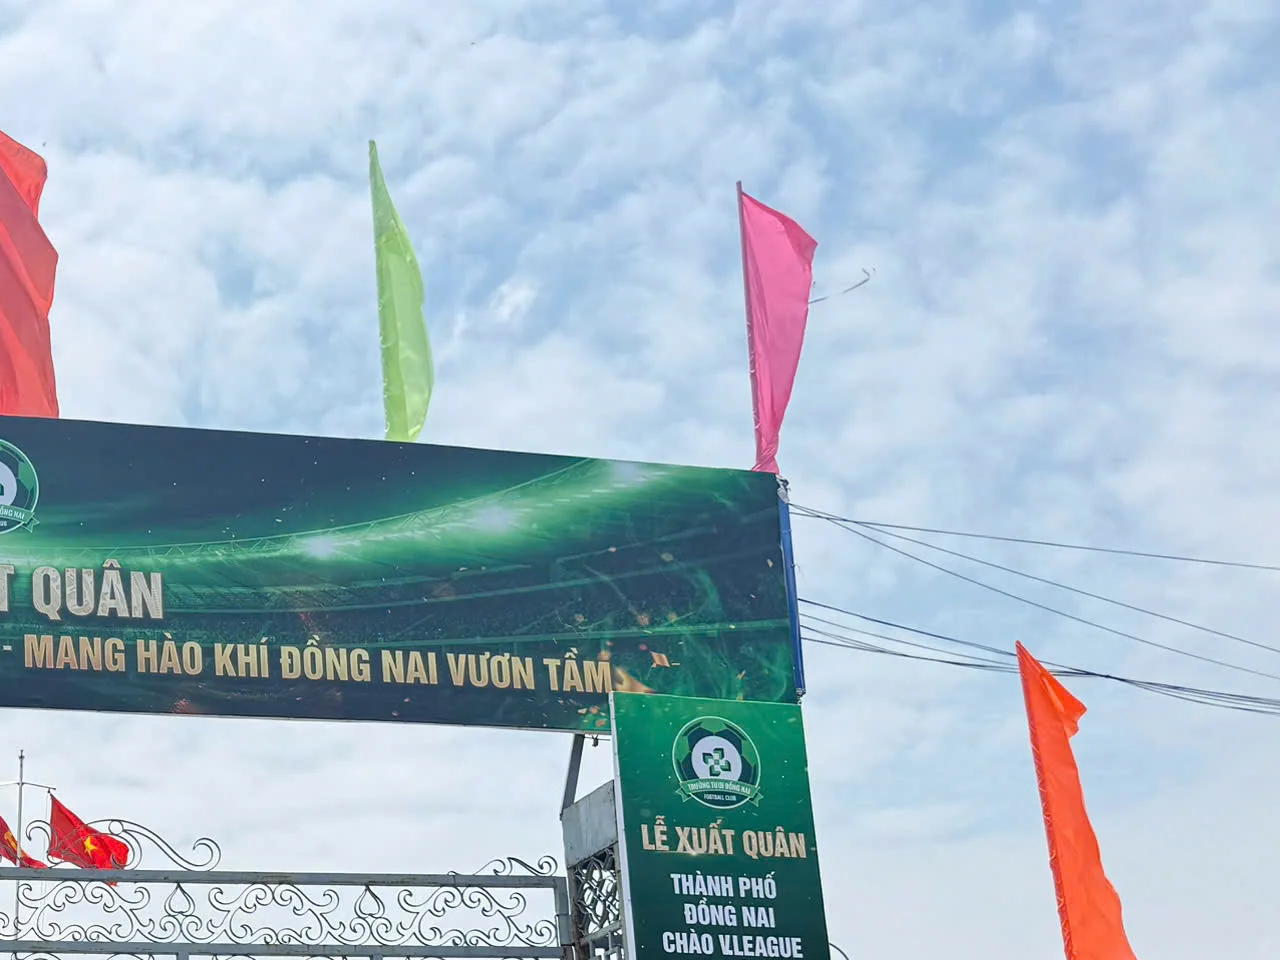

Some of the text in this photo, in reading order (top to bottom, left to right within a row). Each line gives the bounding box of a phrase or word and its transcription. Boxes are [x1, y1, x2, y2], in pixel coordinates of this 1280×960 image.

[32, 558, 163, 620] QUÂN
[24, 634, 126, 672] MANG
[136, 632, 203, 675] HÀO
[214, 636, 269, 678] KHÍ
[280, 634, 370, 682] ĐỒNG
[381, 649, 438, 685] NAI
[446, 651, 535, 690] VƯƠN
[543, 647, 613, 693] TẦM
[641, 816, 806, 859] LỄ XUẤT QUÂN
[670, 870, 777, 899] THÀNH PHỐ
[684, 898, 775, 928] ĐỒNG NAI
[662, 930, 713, 955] CHÀO
